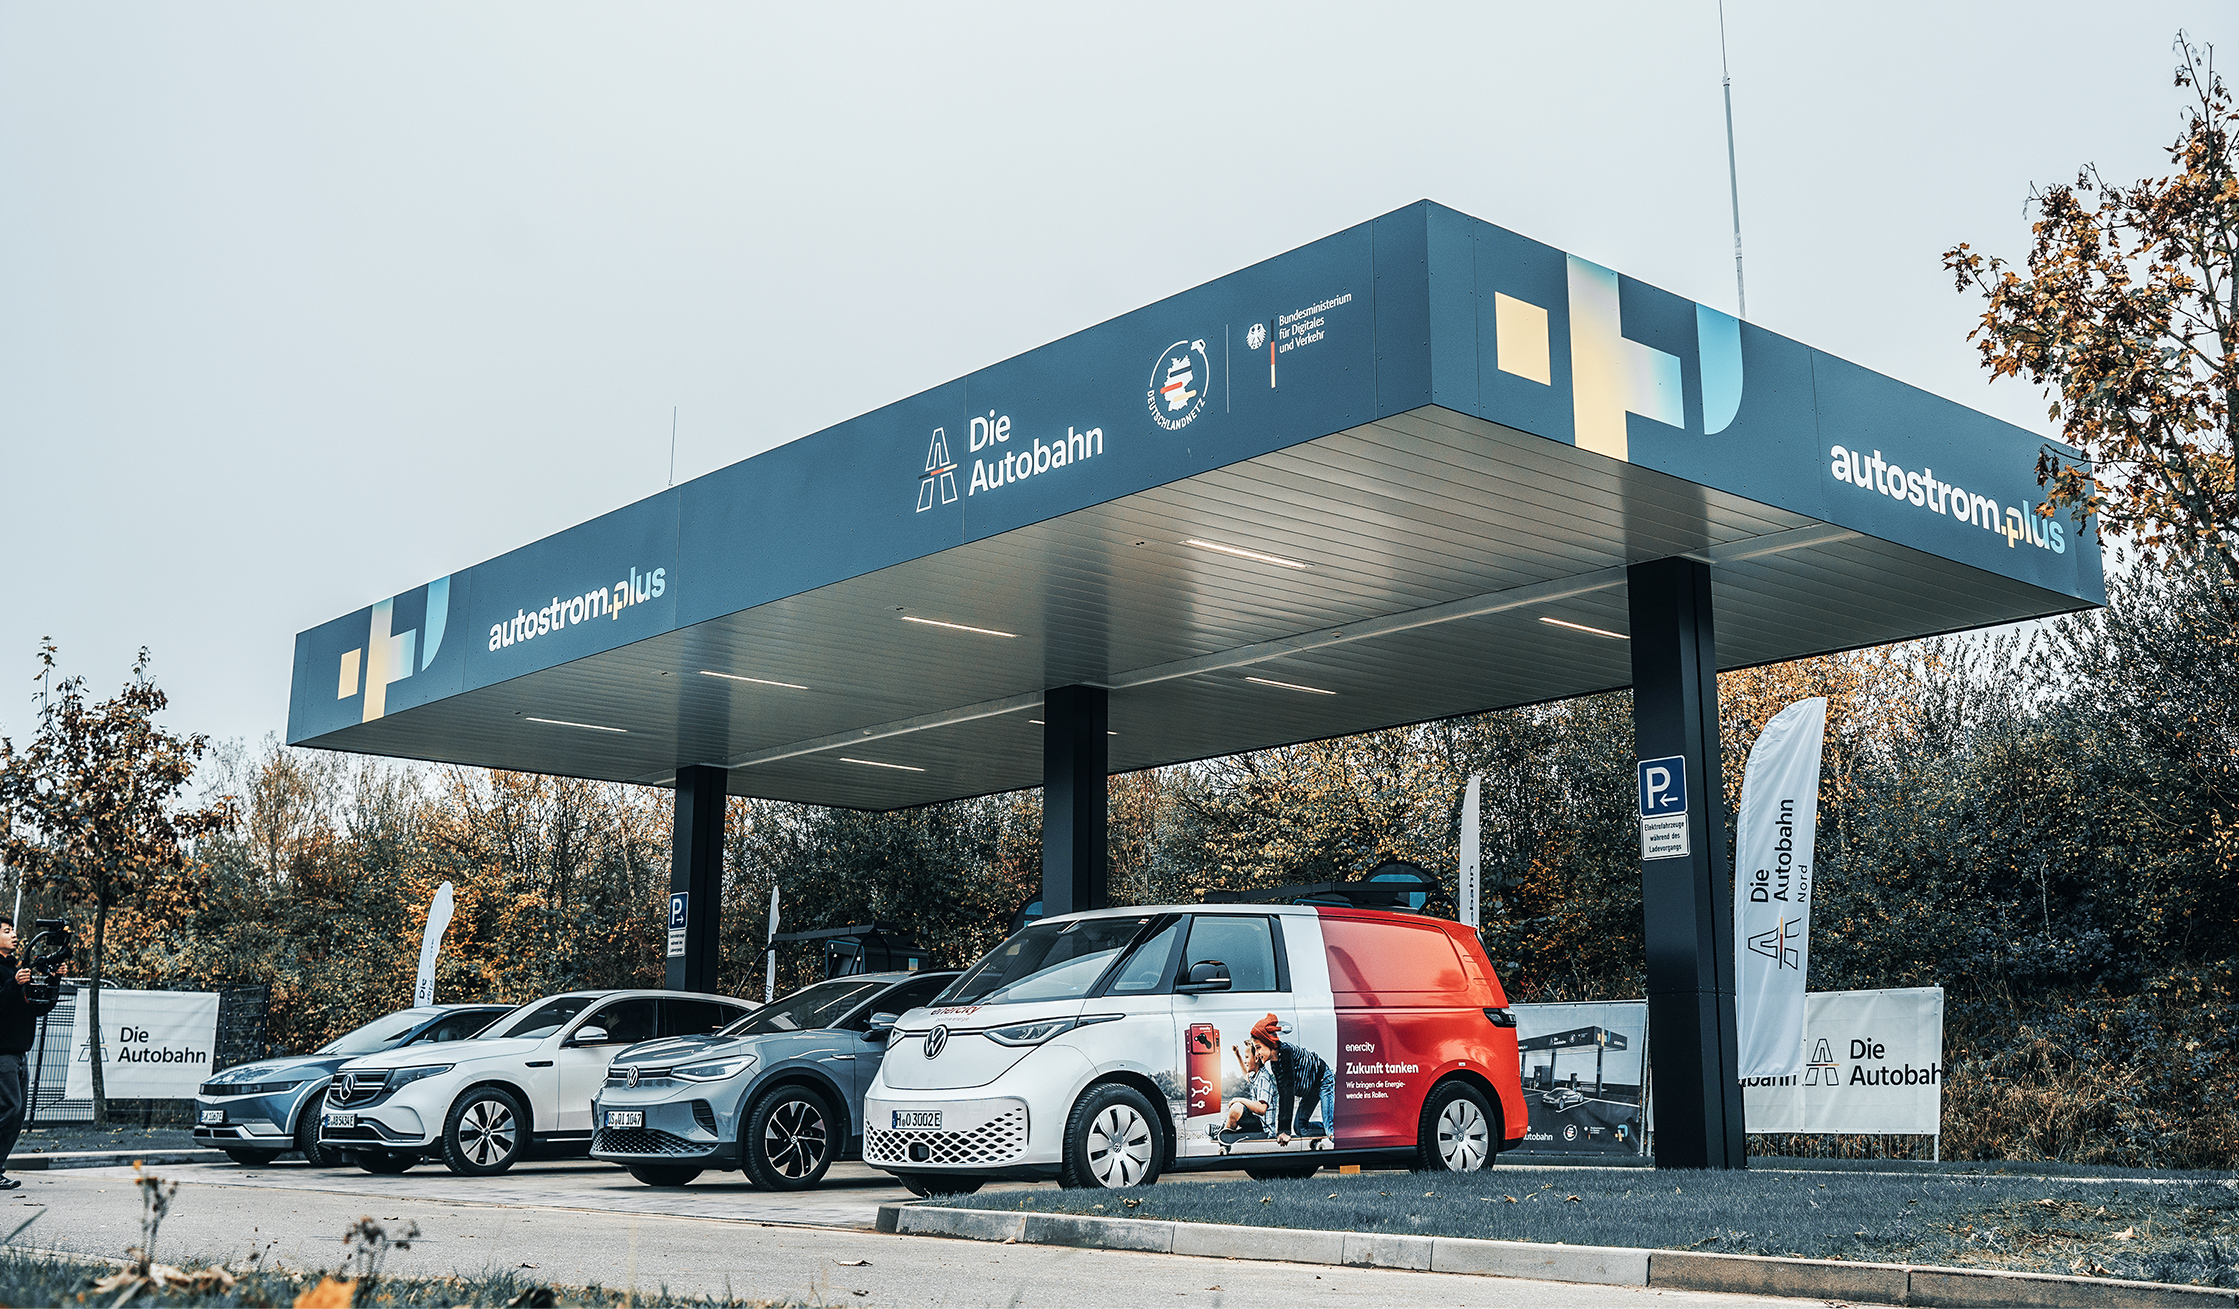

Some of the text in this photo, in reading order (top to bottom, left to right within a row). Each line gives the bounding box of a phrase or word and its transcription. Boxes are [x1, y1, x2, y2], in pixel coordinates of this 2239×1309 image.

[1279, 293, 1352, 326] Bundesministerium
[1279, 316, 1325, 340] für Digitales
[1279, 330, 1325, 353] und Verkehr
[1147, 389, 1206, 431] DEUTSCHLANDNETZ
[969, 409, 1011, 453] Die
[968, 426, 1103, 496] Autobahn
[1830, 443, 2065, 554] autostrom.plus
[488, 567, 666, 652] autostrom.plus
[1646, 766, 1671, 809] P
[1644, 821, 1684, 832] Elektrofahrzeuge
[1649, 832, 1681, 842] während des
[1649, 843, 1682, 853] Ladevorgangs
[1773, 799, 1794, 902] Autobahn
[1749, 869, 1770, 903] Die
[1797, 864, 1808, 903] Nord
[671, 897, 683, 925] P
[119, 1026, 149, 1043] Die
[118, 1046, 206, 1064] Autobahn
[1345, 1041, 1375, 1053] enercity
[1849, 1036, 1886, 1061] Die
[1345, 1061, 1419, 1075] Zukunft tanken
[1355, 1081, 1375, 1090] bringen
[1385, 1080, 1406, 1089] Energie-
[1371, 1091, 1389, 1099] Rollen.
[1523, 1132, 1553, 1141] utobahn
